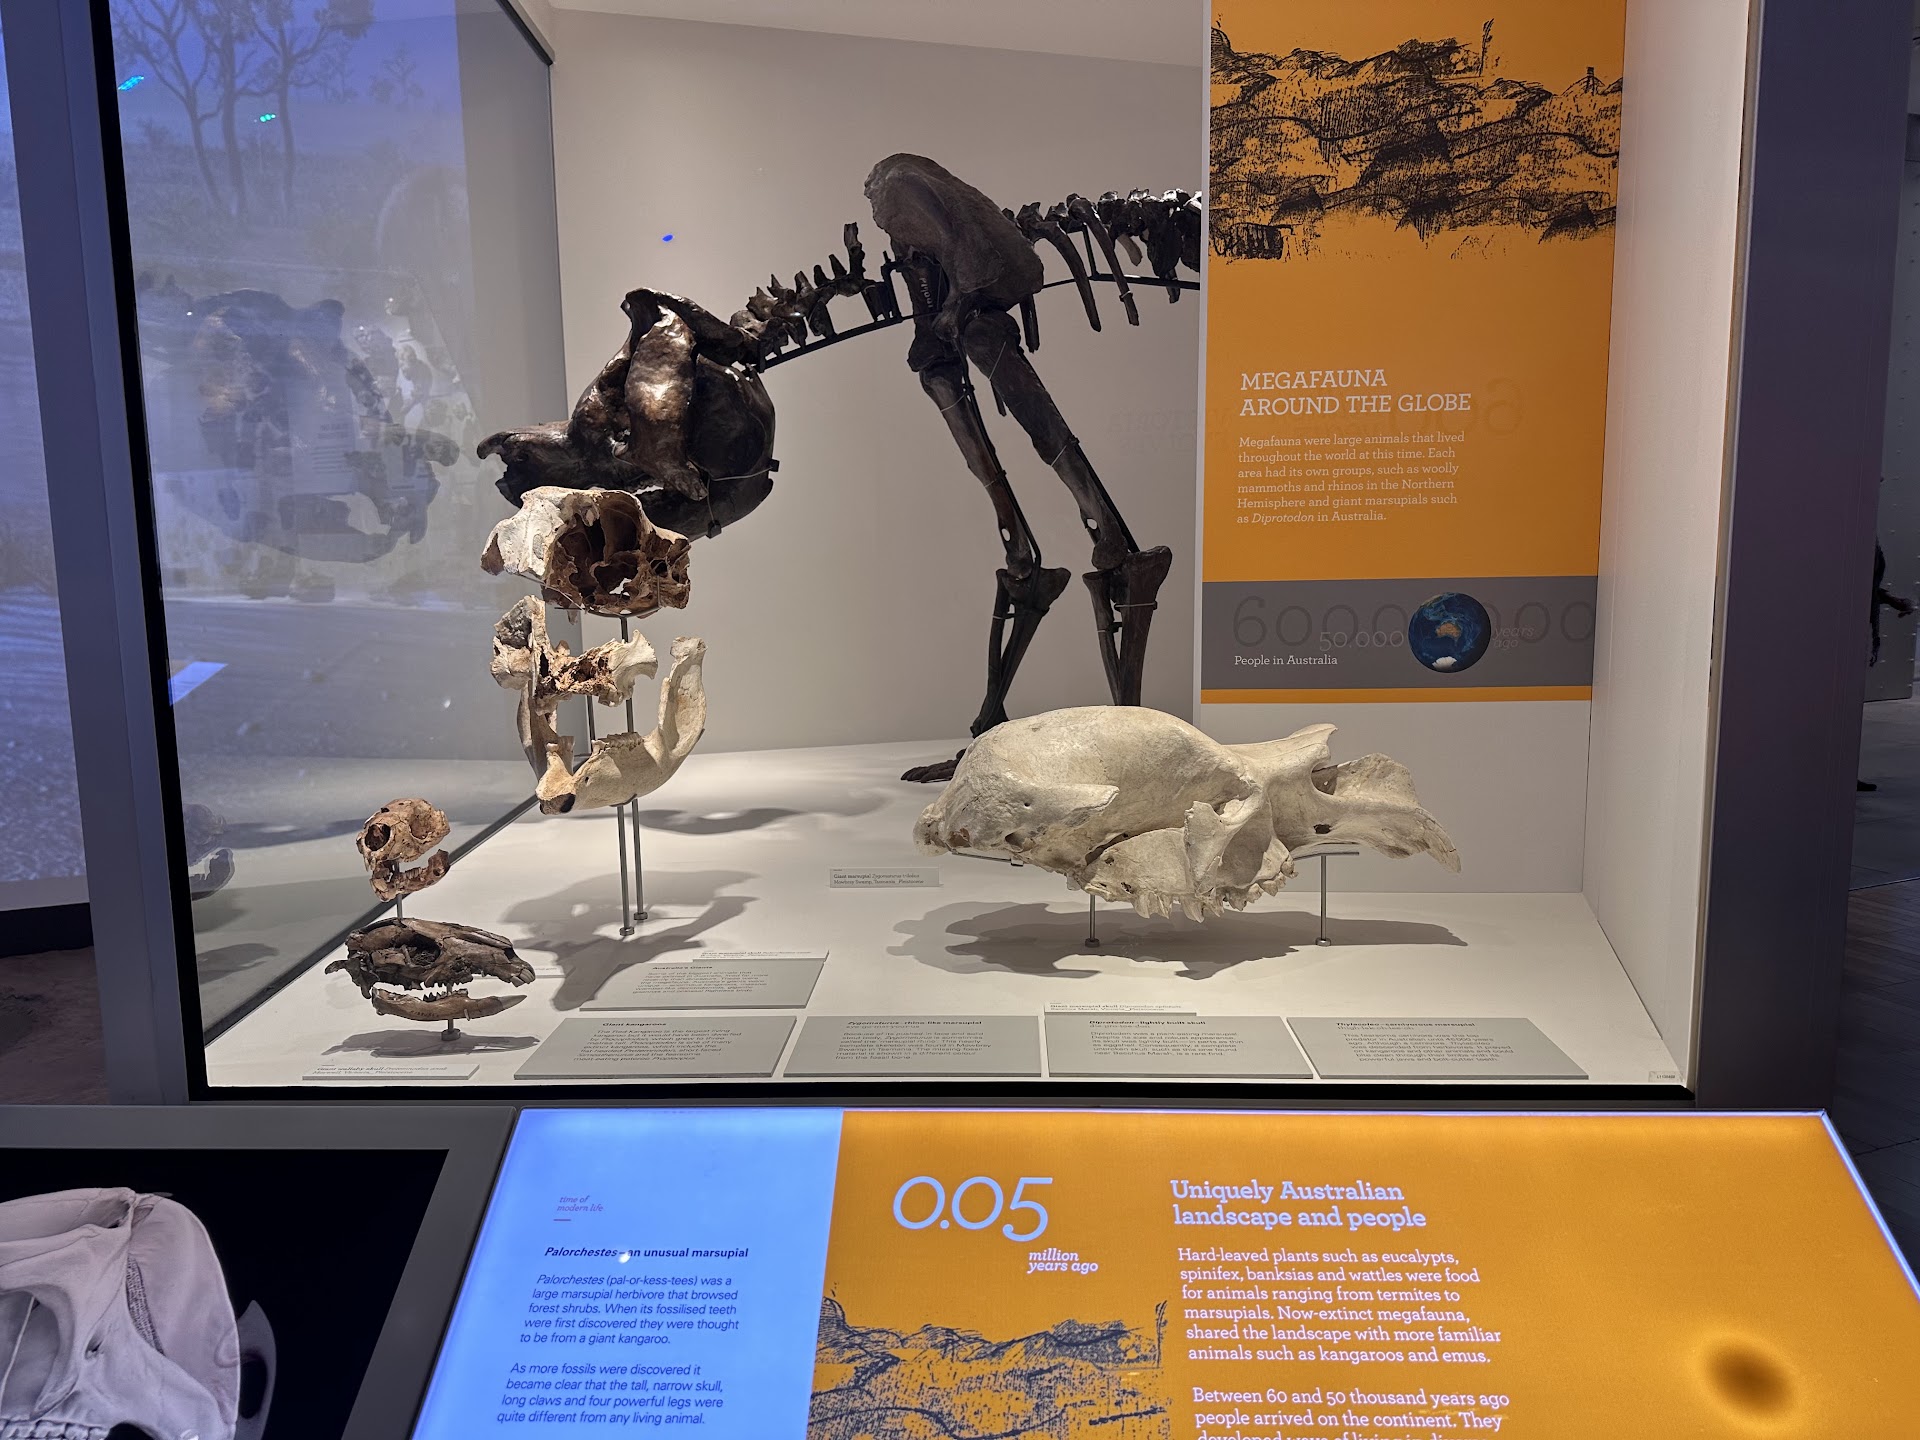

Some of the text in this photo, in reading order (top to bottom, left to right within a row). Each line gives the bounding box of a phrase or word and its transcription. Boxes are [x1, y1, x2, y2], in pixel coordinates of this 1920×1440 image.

[1240, 369, 1387, 390] MEGAFAUNA
[1239, 393, 1471, 416] AROUND THE GLOBE
[1239, 435, 1301, 449] Megafauna
[1333, 433, 1362, 446] large
[1364, 432, 1409, 443] animals
[1412, 431, 1434, 442] that
[1437, 430, 1464, 442] lived
[1238, 446, 1455, 464] throughout the world at this time. Each
[1265, 466, 1286, 477] had
[1289, 467, 1302, 476] its
[1305, 468, 1329, 476] own
[1332, 467, 1374, 478] groups,
[1377, 463, 1403, 474] such
[1421, 462, 1459, 475] woolly
[1237, 477, 1454, 493] mammoths and rhinos in the Northern
[1237, 492, 1457, 510] Hemisphere and giant marsupials such
[1251, 511, 1314, 525] Diprotodon
[1317, 512, 1328, 521] in
[1331, 509, 1386, 521] Australia.
[1234, 654, 1337, 667] People in Australia
[579, 1195, 590, 1203] of
[1170, 1179, 1405, 1204] Uniquely Australian
[589, 1203, 603, 1211] life
[893, 1176, 1053, 1241] 0.05
[1172, 1205, 1426, 1231] landscape and people
[544, 1247, 617, 1256] Palorchestes
[644, 1248, 689, 1257] unusual
[691, 1248, 748, 1259] marsupial
[1029, 1248, 1079, 1261] million
[1177, 1247, 1459, 1266] Hard-leaved plants such as eucalypts,
[1026, 1262, 1098, 1274] years ago
[1180, 1265, 1480, 1283] spinifex, banksias and wattles were food
[536, 1274, 604, 1284] Palorchestes
[606, 1275, 697, 1286] (pal-or-kess-tees)
[700, 1277, 722, 1285] was
[532, 1288, 738, 1300] large marsupial herbivore that browsed
[1181, 1284, 1460, 1303] for animals ranging from termites to
[528, 1302, 736, 1314] forest shrubs. When its fossilised teeth
[1184, 1304, 1470, 1324] marsupials. Now-extinct megafauna,
[554, 1317, 575, 1327] first
[578, 1318, 637, 1328] discovered
[640, 1318, 663, 1330] they
[666, 1321, 693, 1329] were
[697, 1319, 739, 1331] thought
[1186, 1323, 1501, 1343] shared the landscape with more familiar
[1188, 1344, 1490, 1364] animals such as kangaroos and emus.
[1192, 1387, 1510, 1410] Between 60 and 50 thousand years ago
[1194, 1409, 1502, 1432] people arrived on the continent. They
